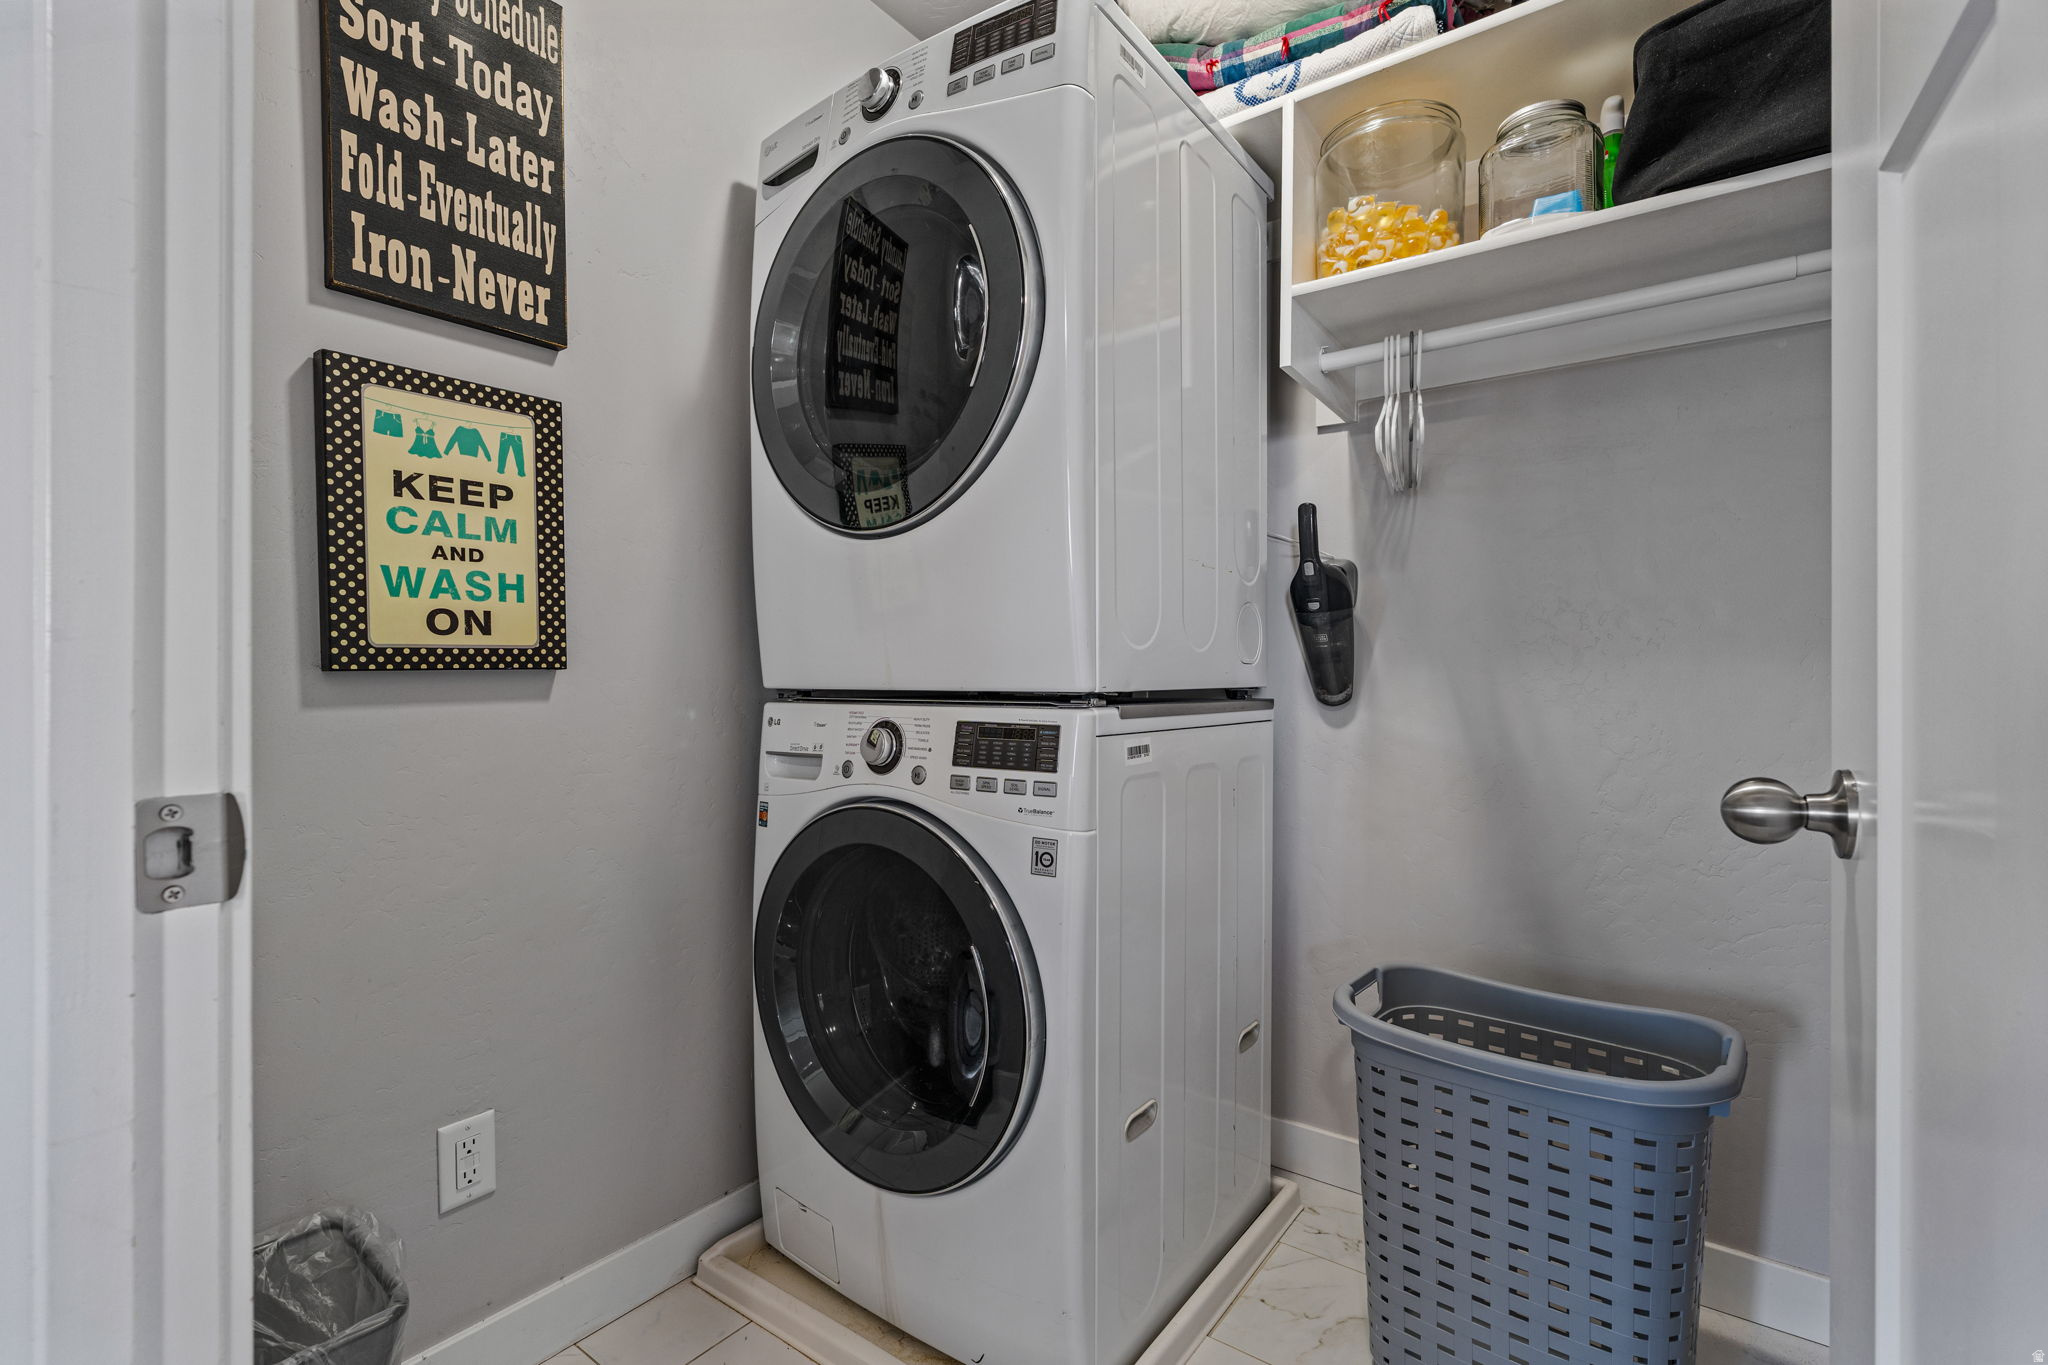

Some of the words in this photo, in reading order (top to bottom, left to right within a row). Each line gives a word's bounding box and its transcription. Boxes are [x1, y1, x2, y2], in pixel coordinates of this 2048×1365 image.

[392, 469, 514, 510] KEEP
[385, 506, 518, 544] CALM
[431, 545, 484, 563] AND
[379, 564, 525, 604] WASH
[425, 608, 492, 636] ON
[1034, 851, 1054, 868] 10
